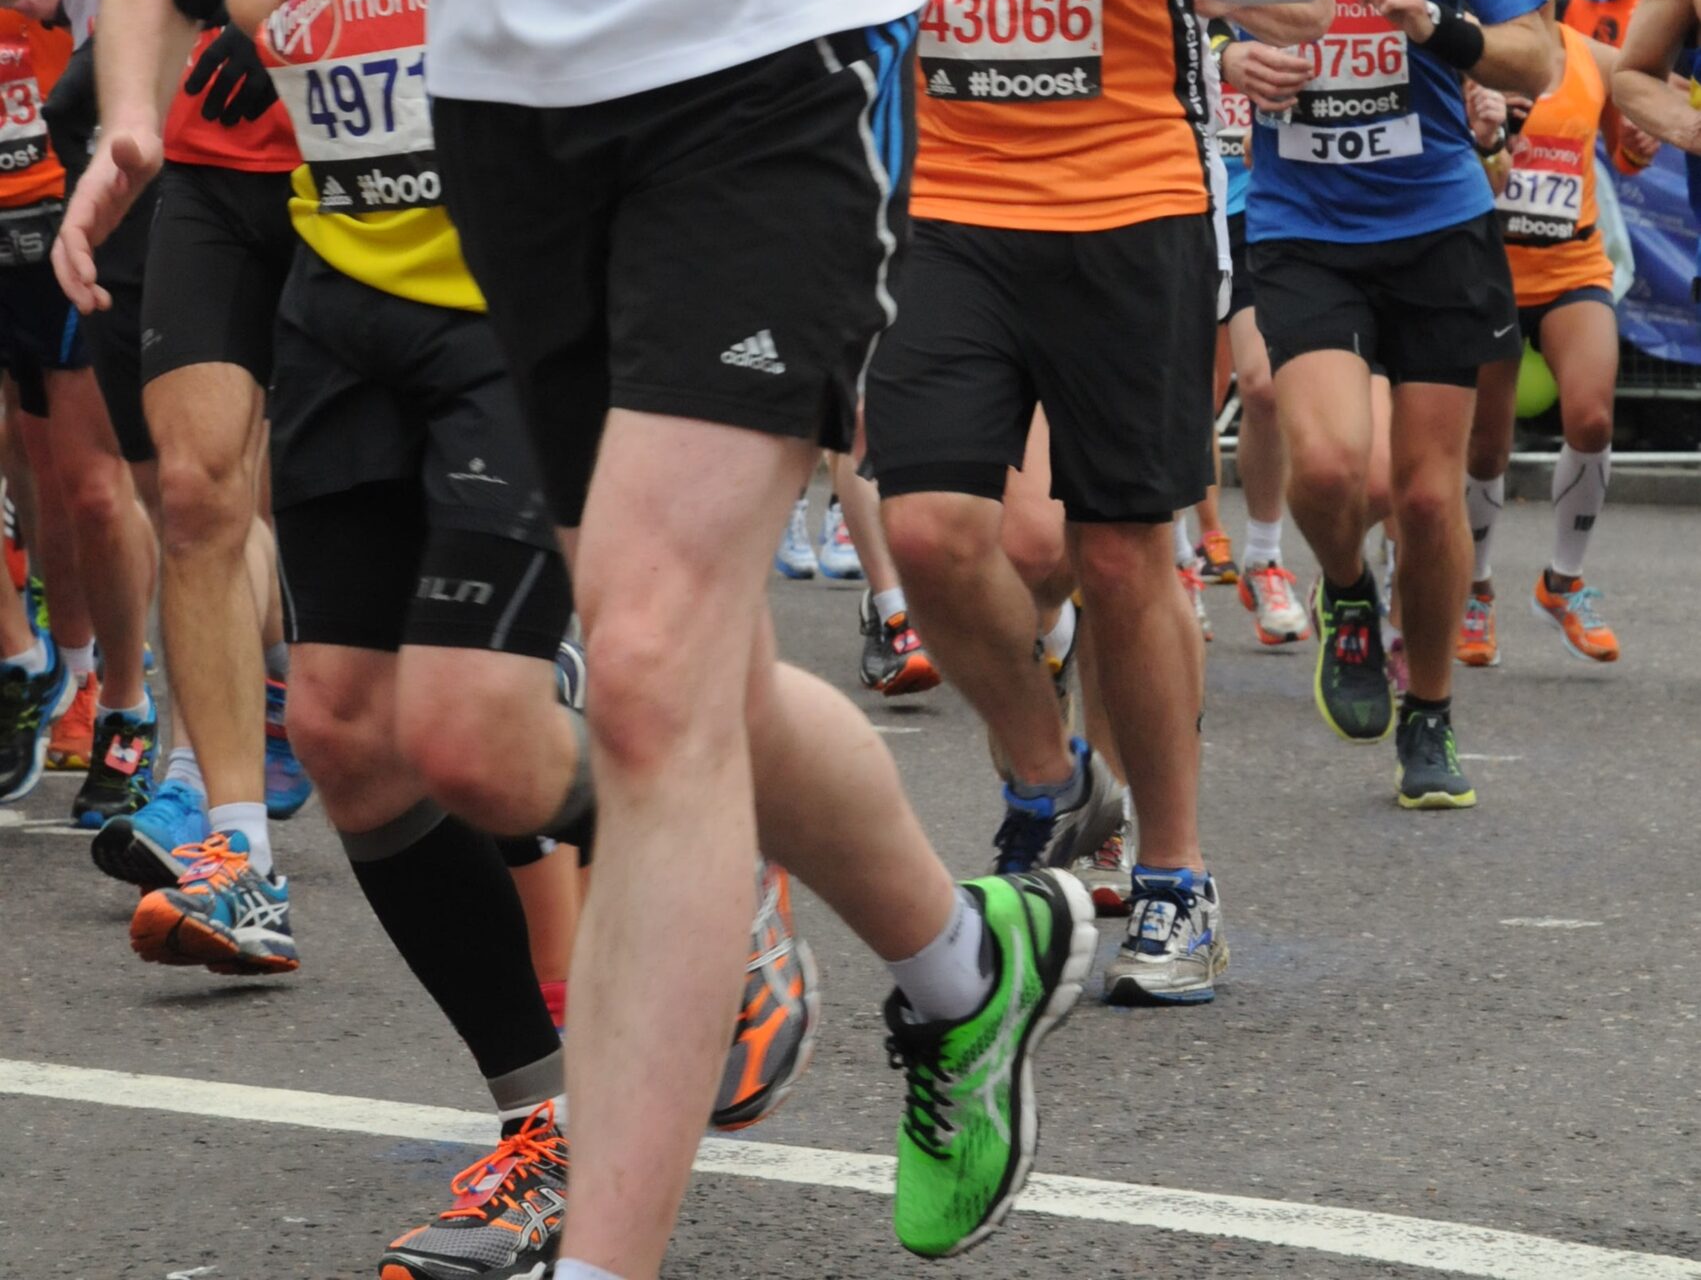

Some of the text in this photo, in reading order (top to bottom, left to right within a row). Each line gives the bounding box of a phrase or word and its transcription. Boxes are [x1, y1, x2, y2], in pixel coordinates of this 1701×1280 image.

[967, 66, 1089, 97] #boost
[1311, 92, 1400, 118] #boost
[1311, 126, 1391, 161] JOE
[1505, 172, 1577, 209] 6172
[1508, 216, 1574, 239] #boost
